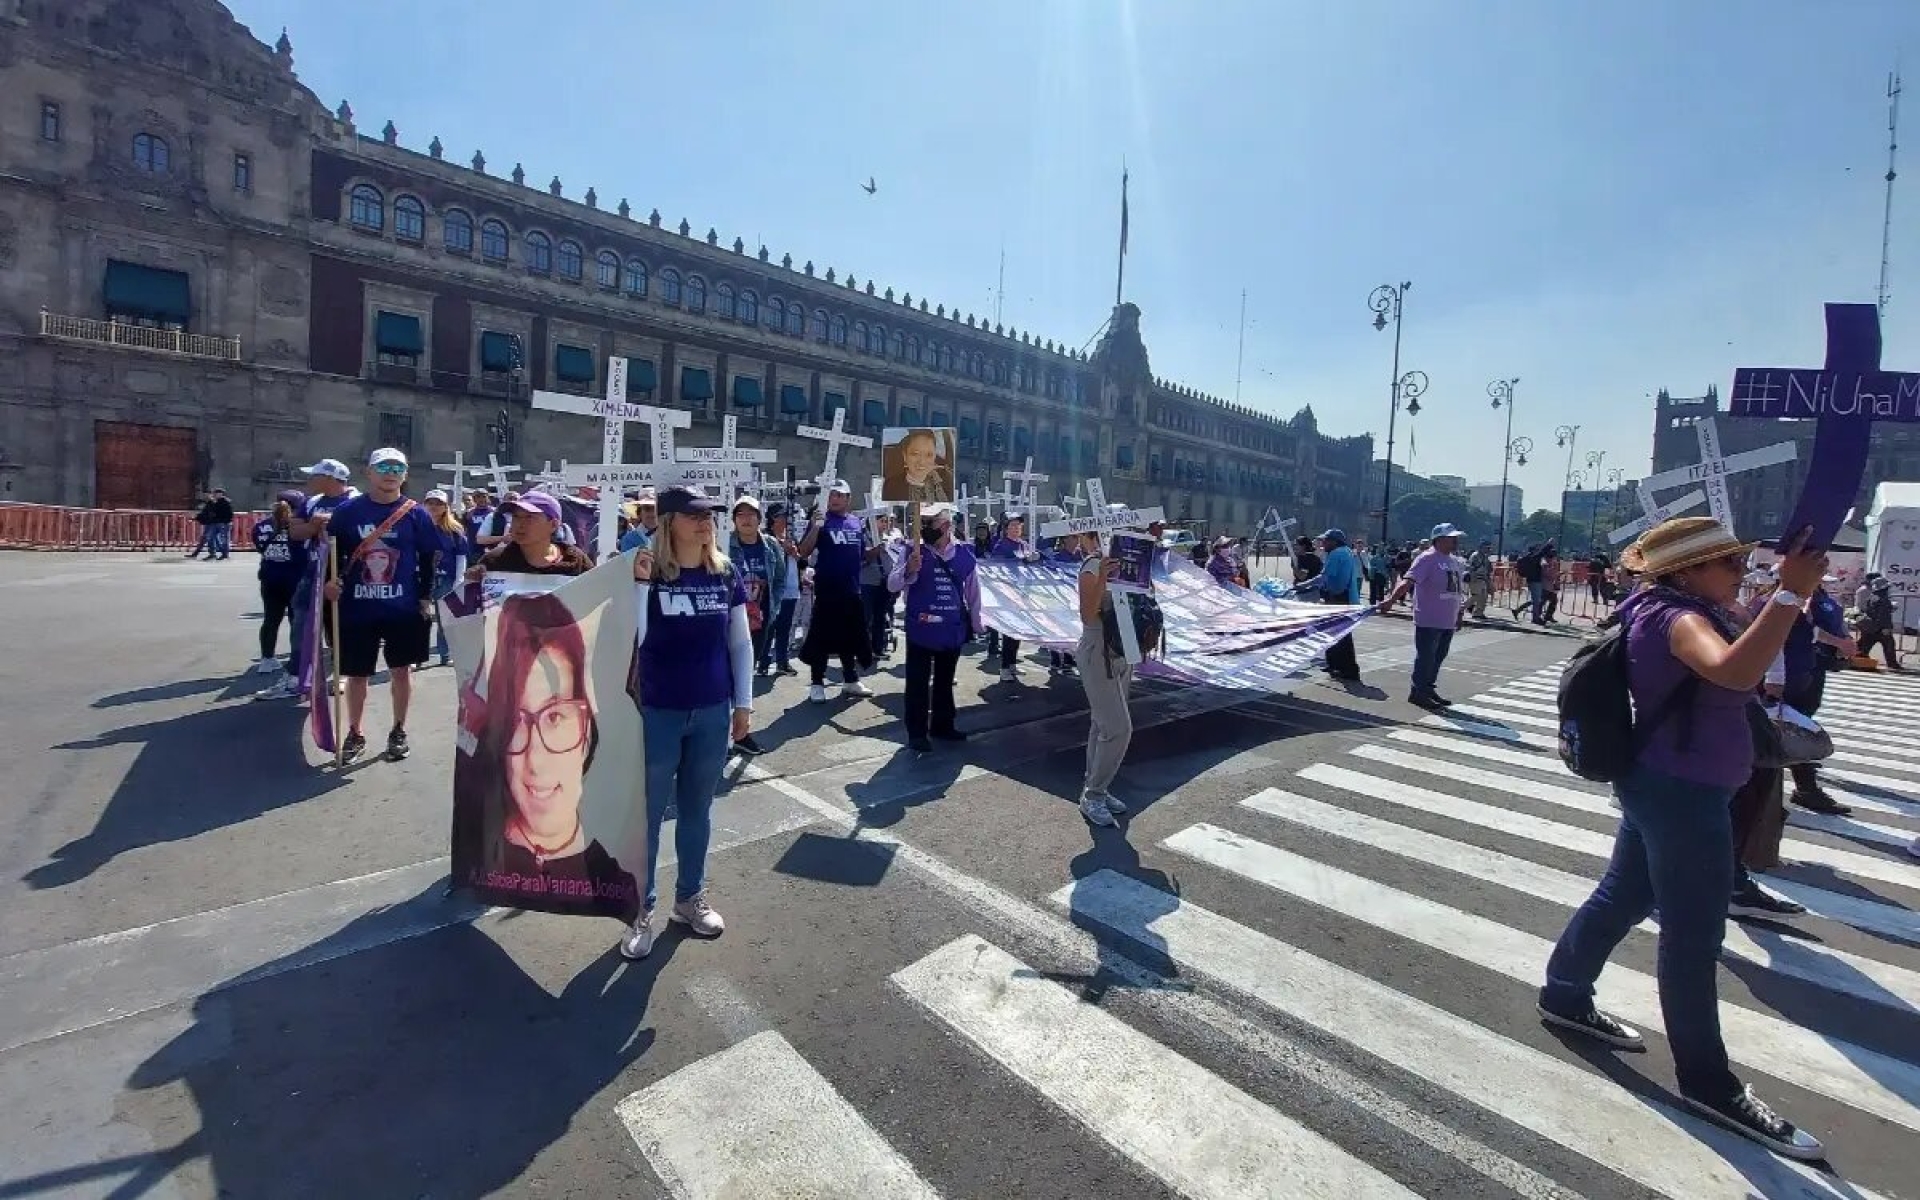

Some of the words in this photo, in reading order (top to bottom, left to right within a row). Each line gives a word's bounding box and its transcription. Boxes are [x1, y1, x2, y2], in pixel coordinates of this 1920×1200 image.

[592, 399, 642, 419] XIMENA
[681, 469, 739, 480] JOSELIN
[1688, 460, 1731, 479] ITZEL
[354, 583, 404, 599] DANIELA
